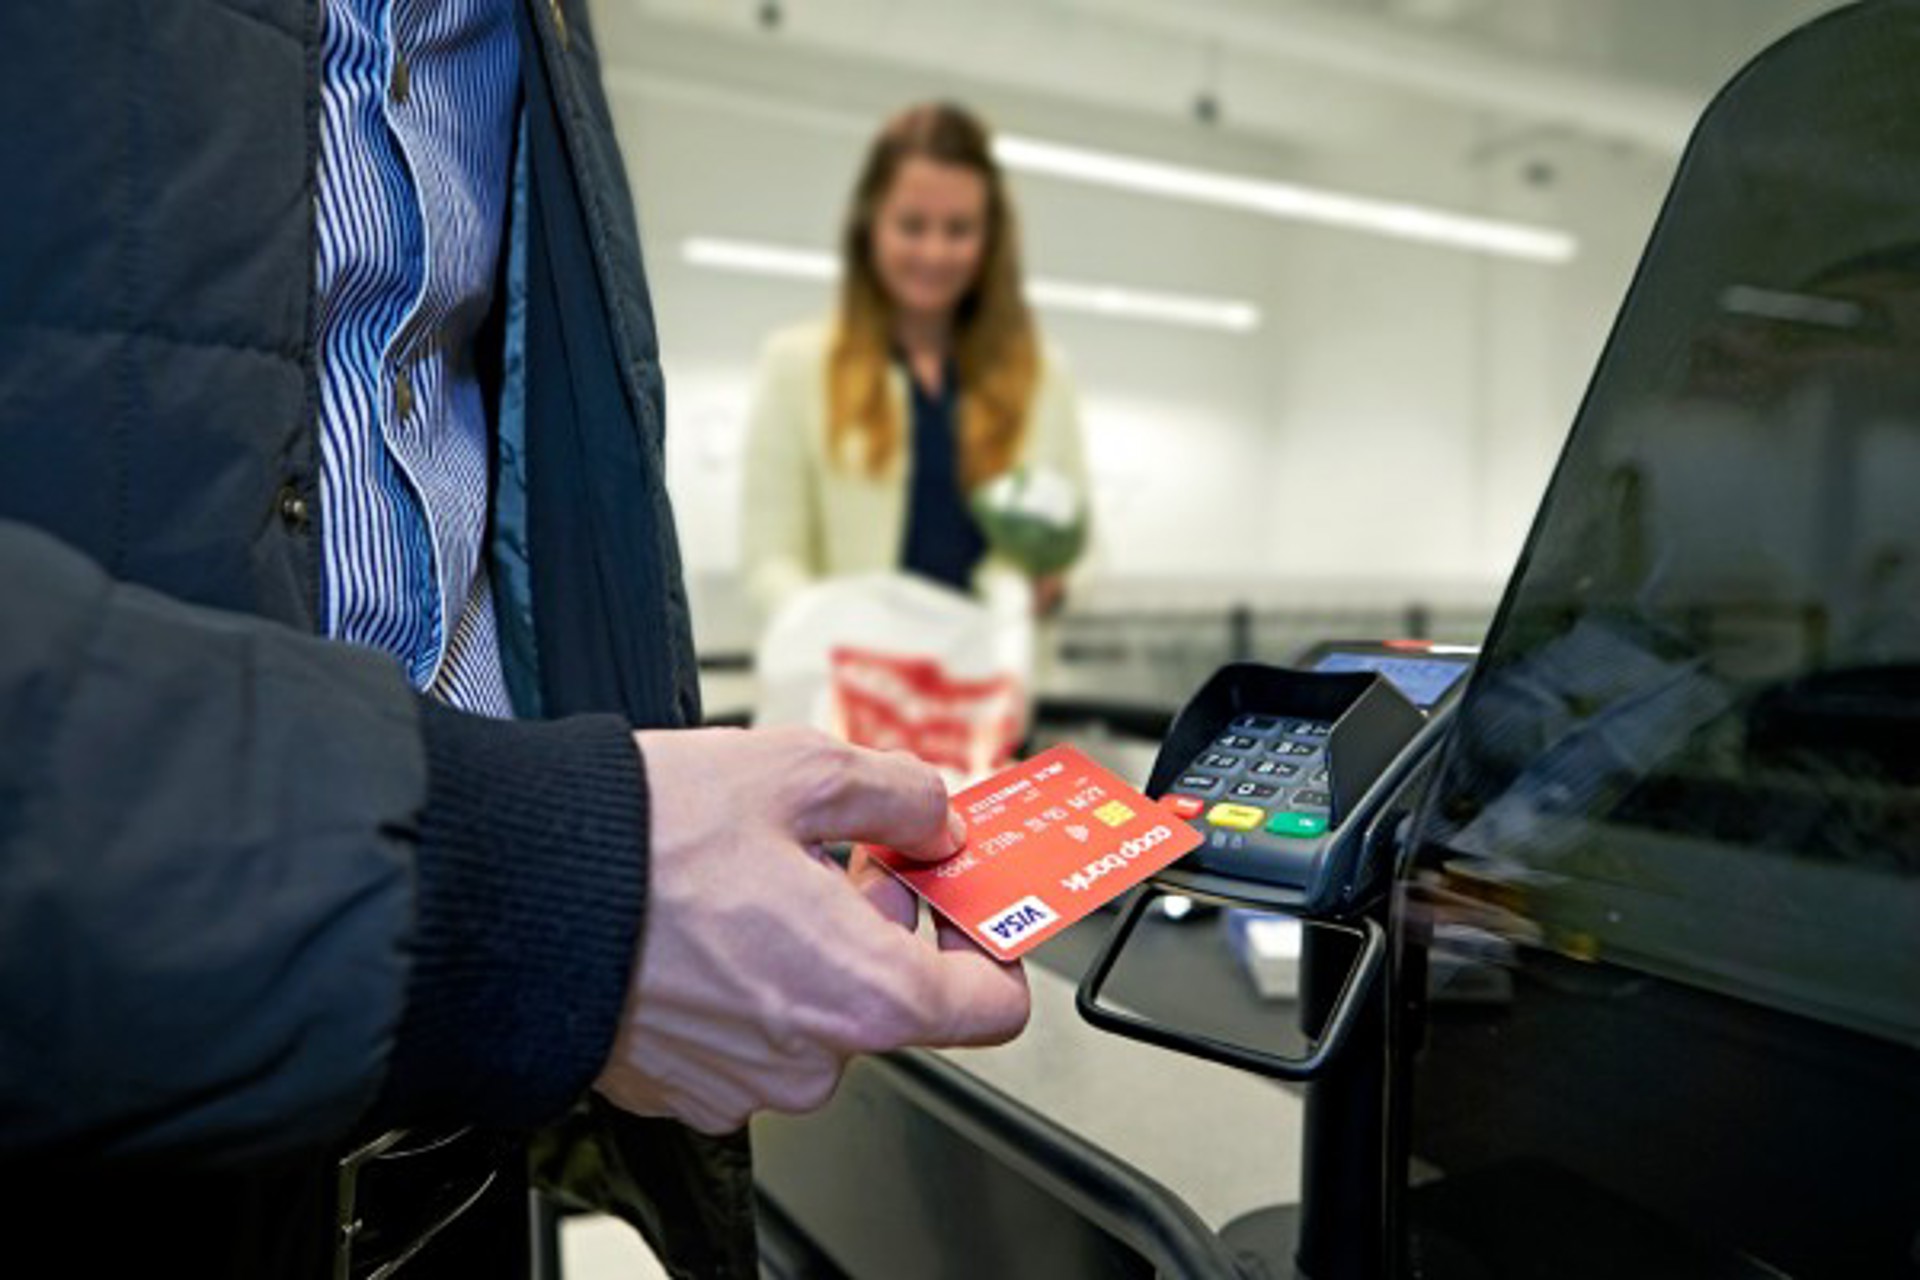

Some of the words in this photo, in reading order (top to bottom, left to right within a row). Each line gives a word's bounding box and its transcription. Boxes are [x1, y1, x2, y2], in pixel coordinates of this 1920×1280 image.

[1119, 825, 1172, 859] coop
[1060, 852, 1128, 892] bank
[990, 904, 1047, 938] VISA
